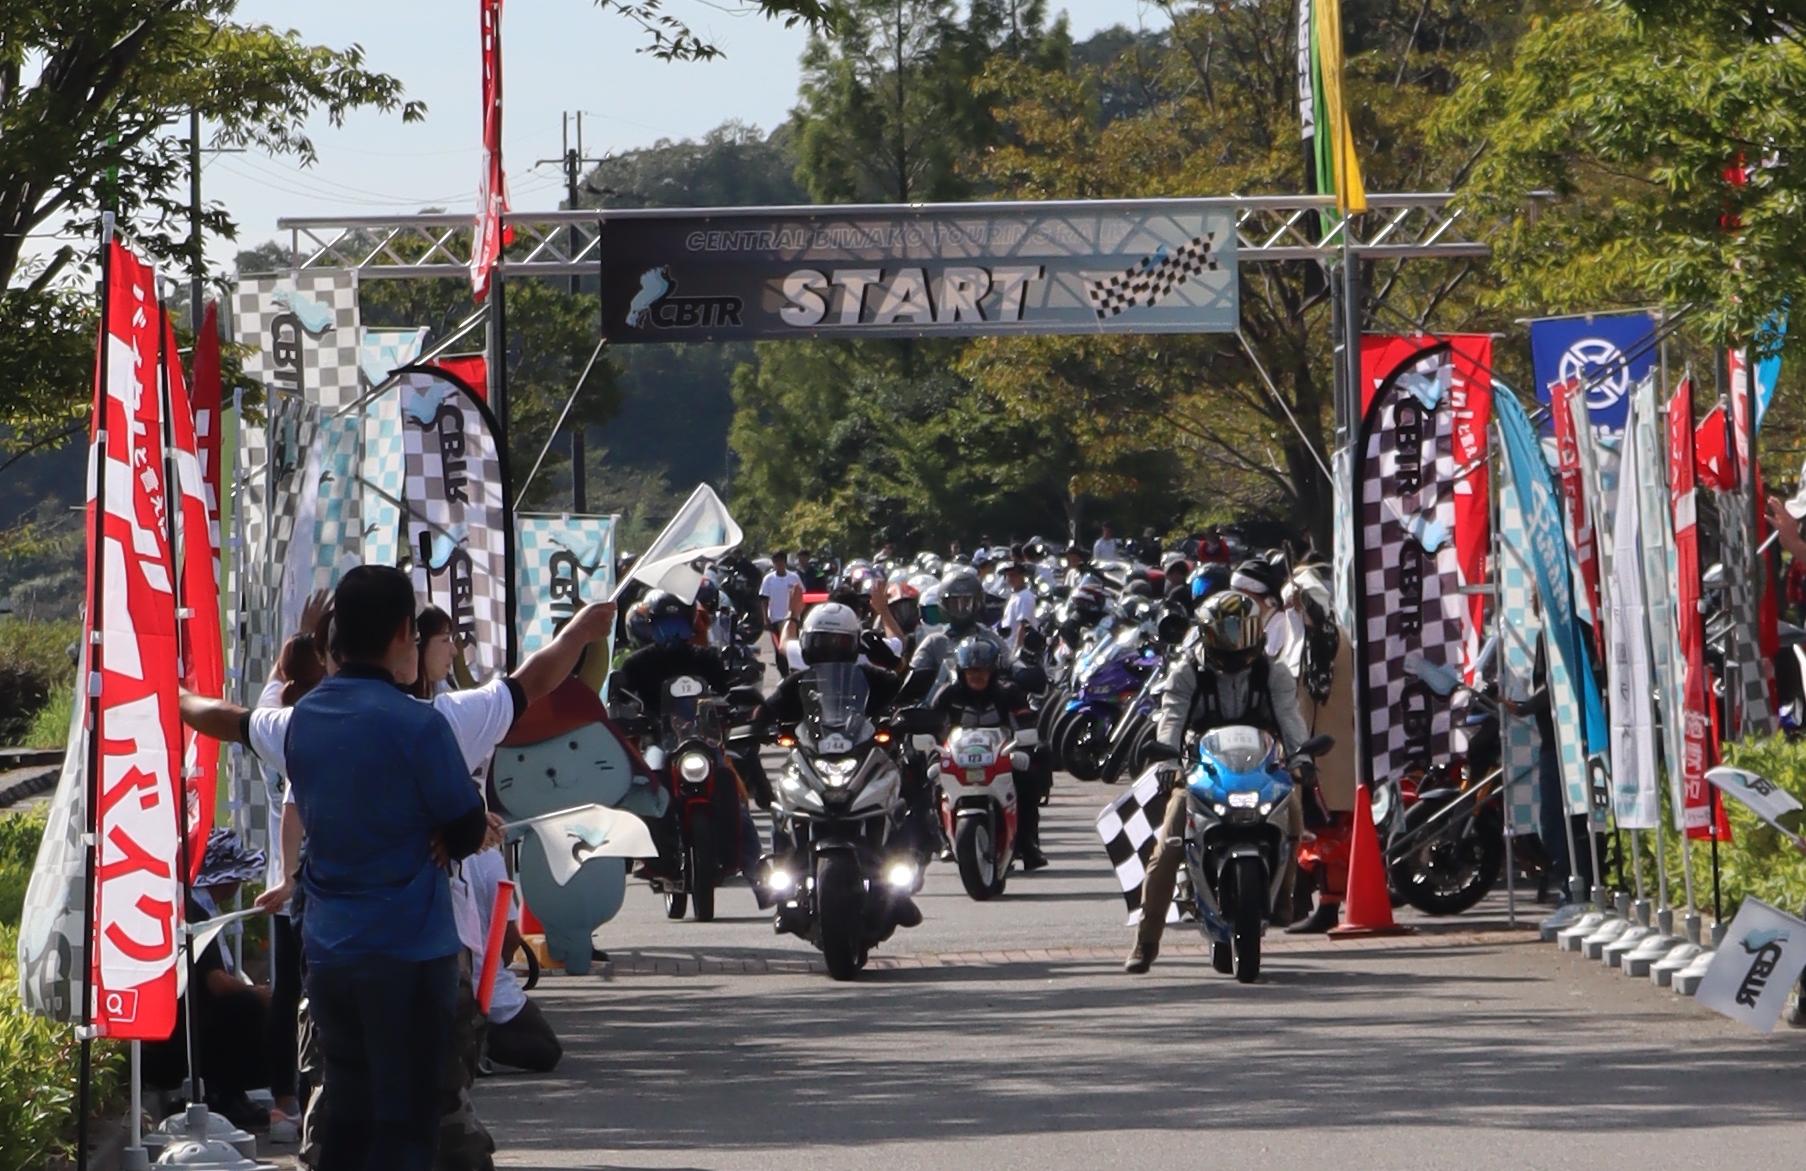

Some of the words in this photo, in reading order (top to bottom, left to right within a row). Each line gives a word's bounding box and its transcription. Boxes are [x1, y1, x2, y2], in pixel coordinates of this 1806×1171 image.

[686, 229, 808, 250] CENTRAL
[812, 226, 924, 249] BIWAKO
[930, 223, 1052, 247] TOURING
[650, 296, 744, 329] CBTR
[780, 265, 1045, 327] START
[271, 311, 305, 402] CBT
[1393, 398, 1423, 495] CBTR
[1399, 537, 1423, 637] CBTR
